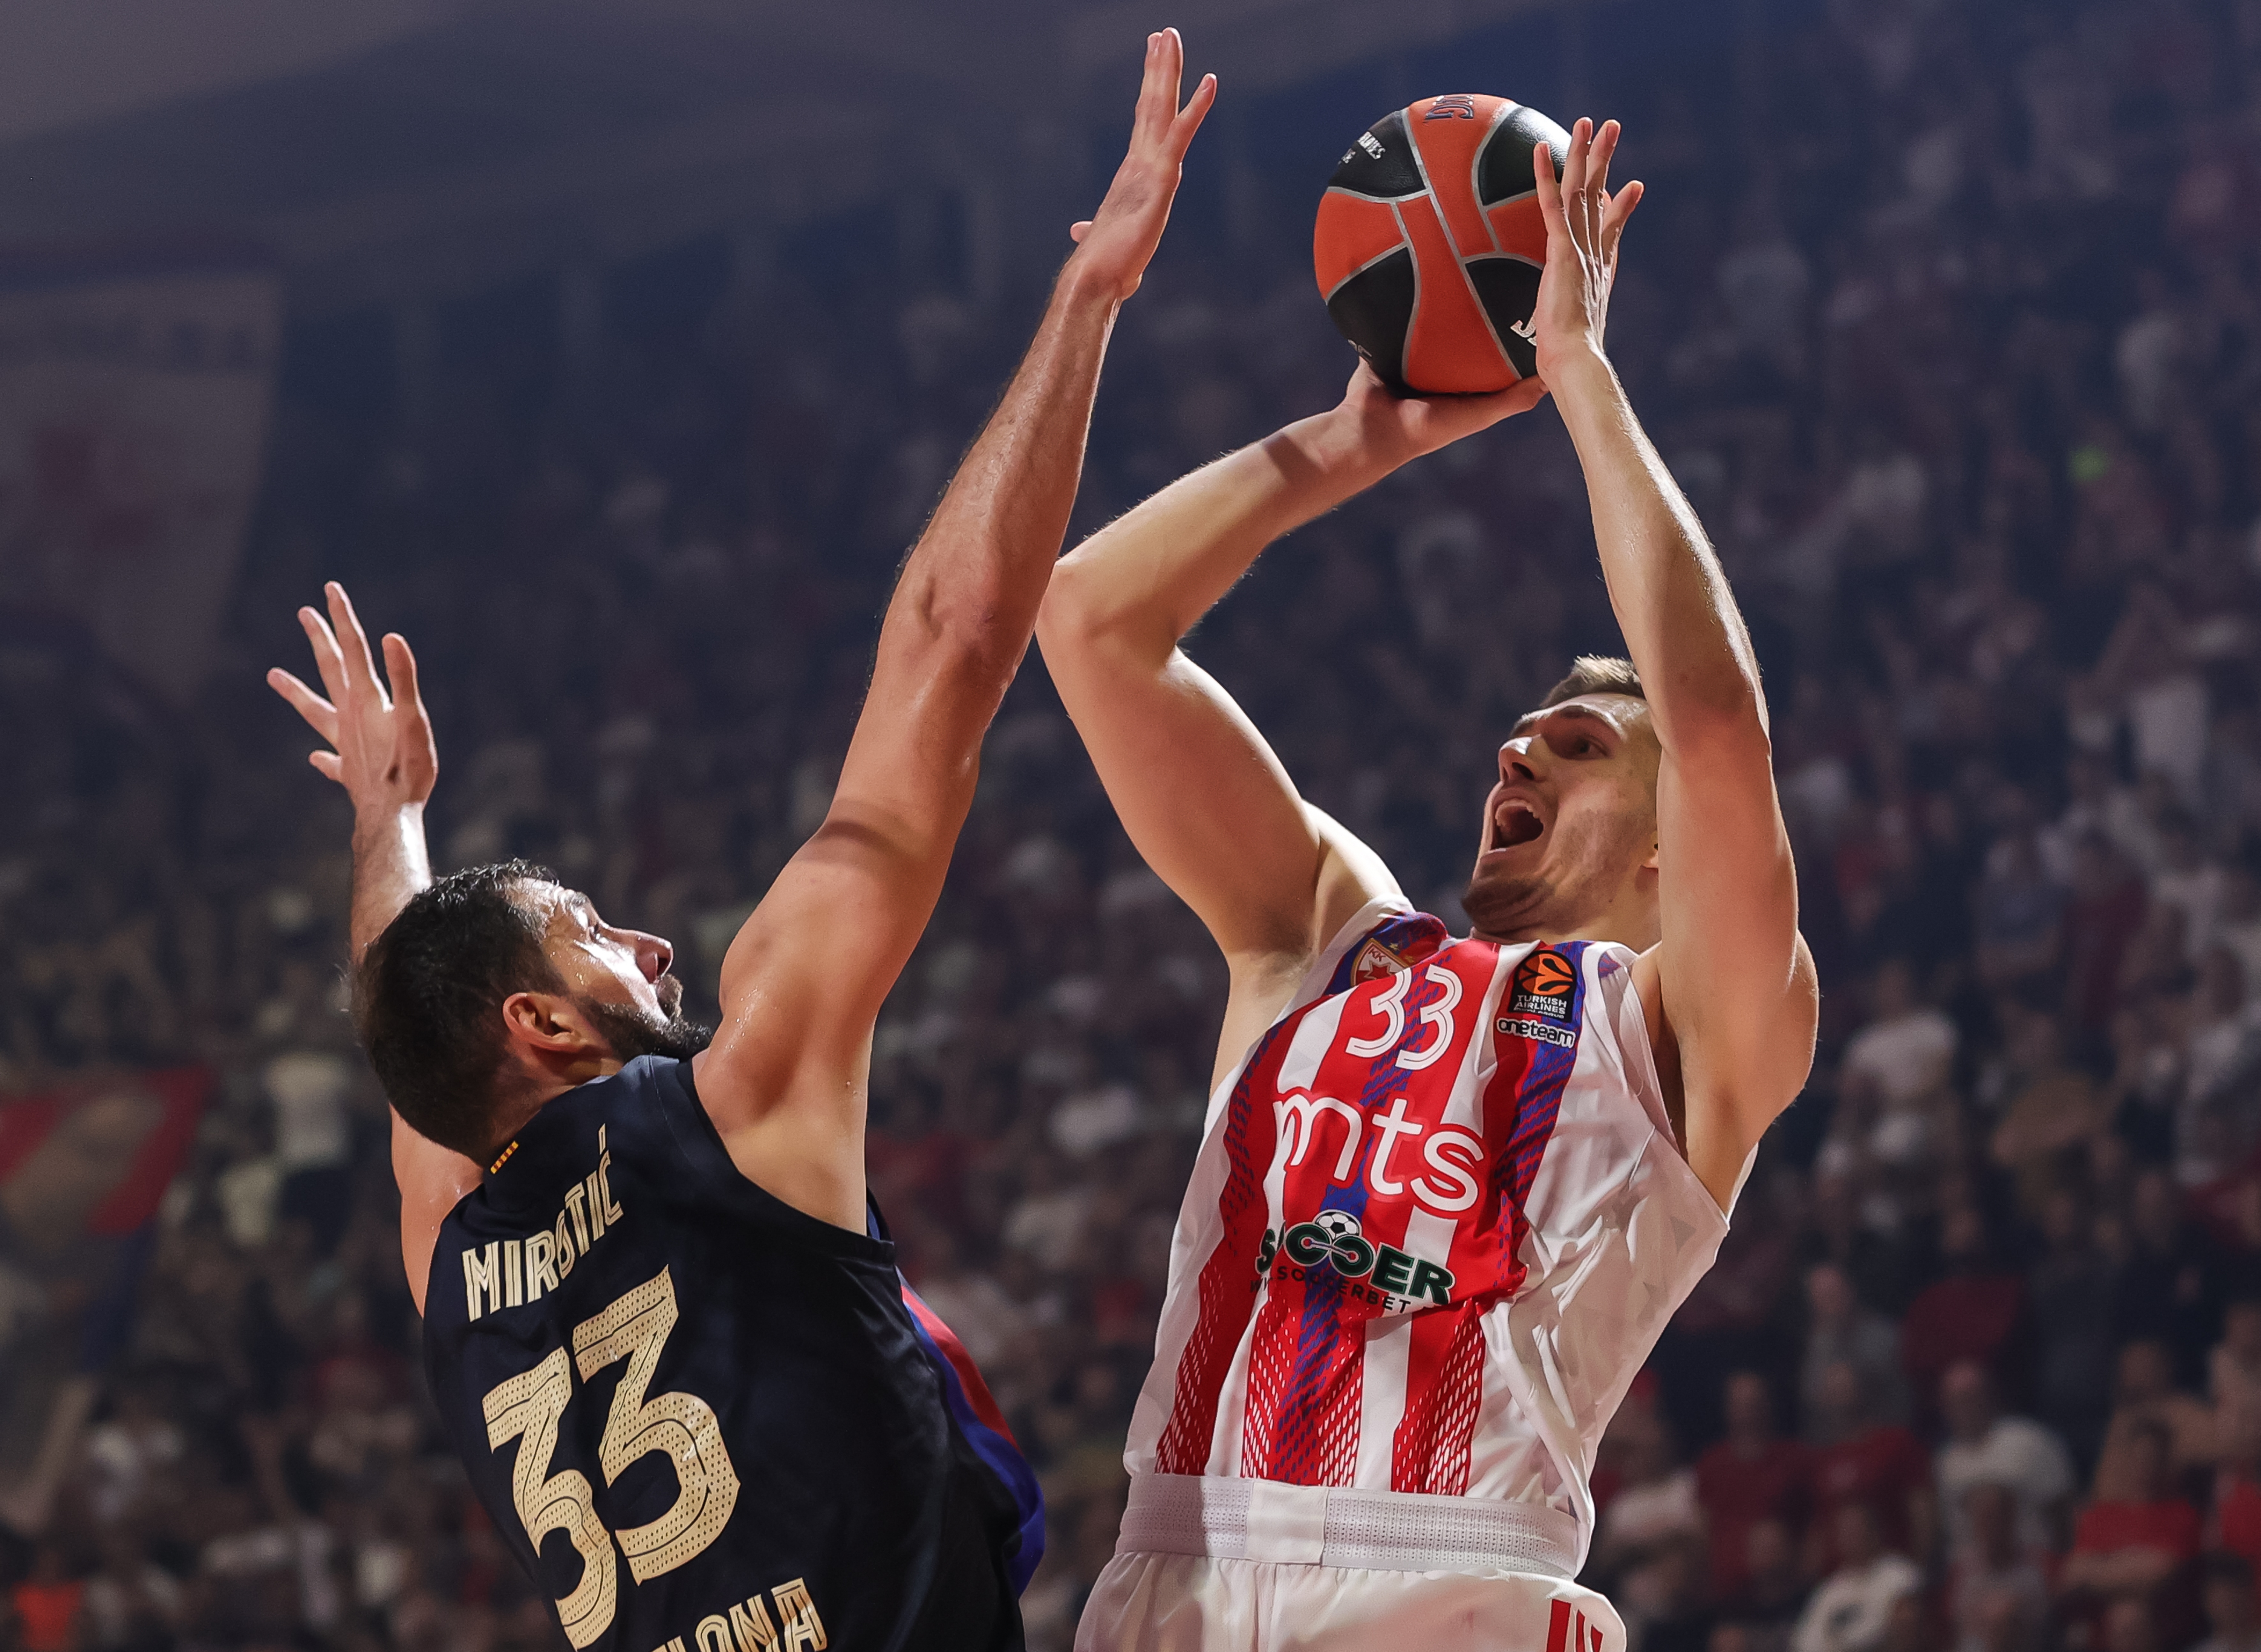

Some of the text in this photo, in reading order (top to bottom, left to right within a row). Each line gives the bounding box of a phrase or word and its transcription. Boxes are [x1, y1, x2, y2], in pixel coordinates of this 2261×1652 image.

[1368, 948, 1386, 962] KK
[1513, 1002, 1565, 1014] AIRLINES
[1517, 995, 1567, 1008] TURKISH
[1345, 964, 1463, 1071] 33
[1273, 1094, 1484, 1212] mts
[462, 1123, 624, 1323] MIROTIĆ
[482, 1263, 741, 1651] 33
